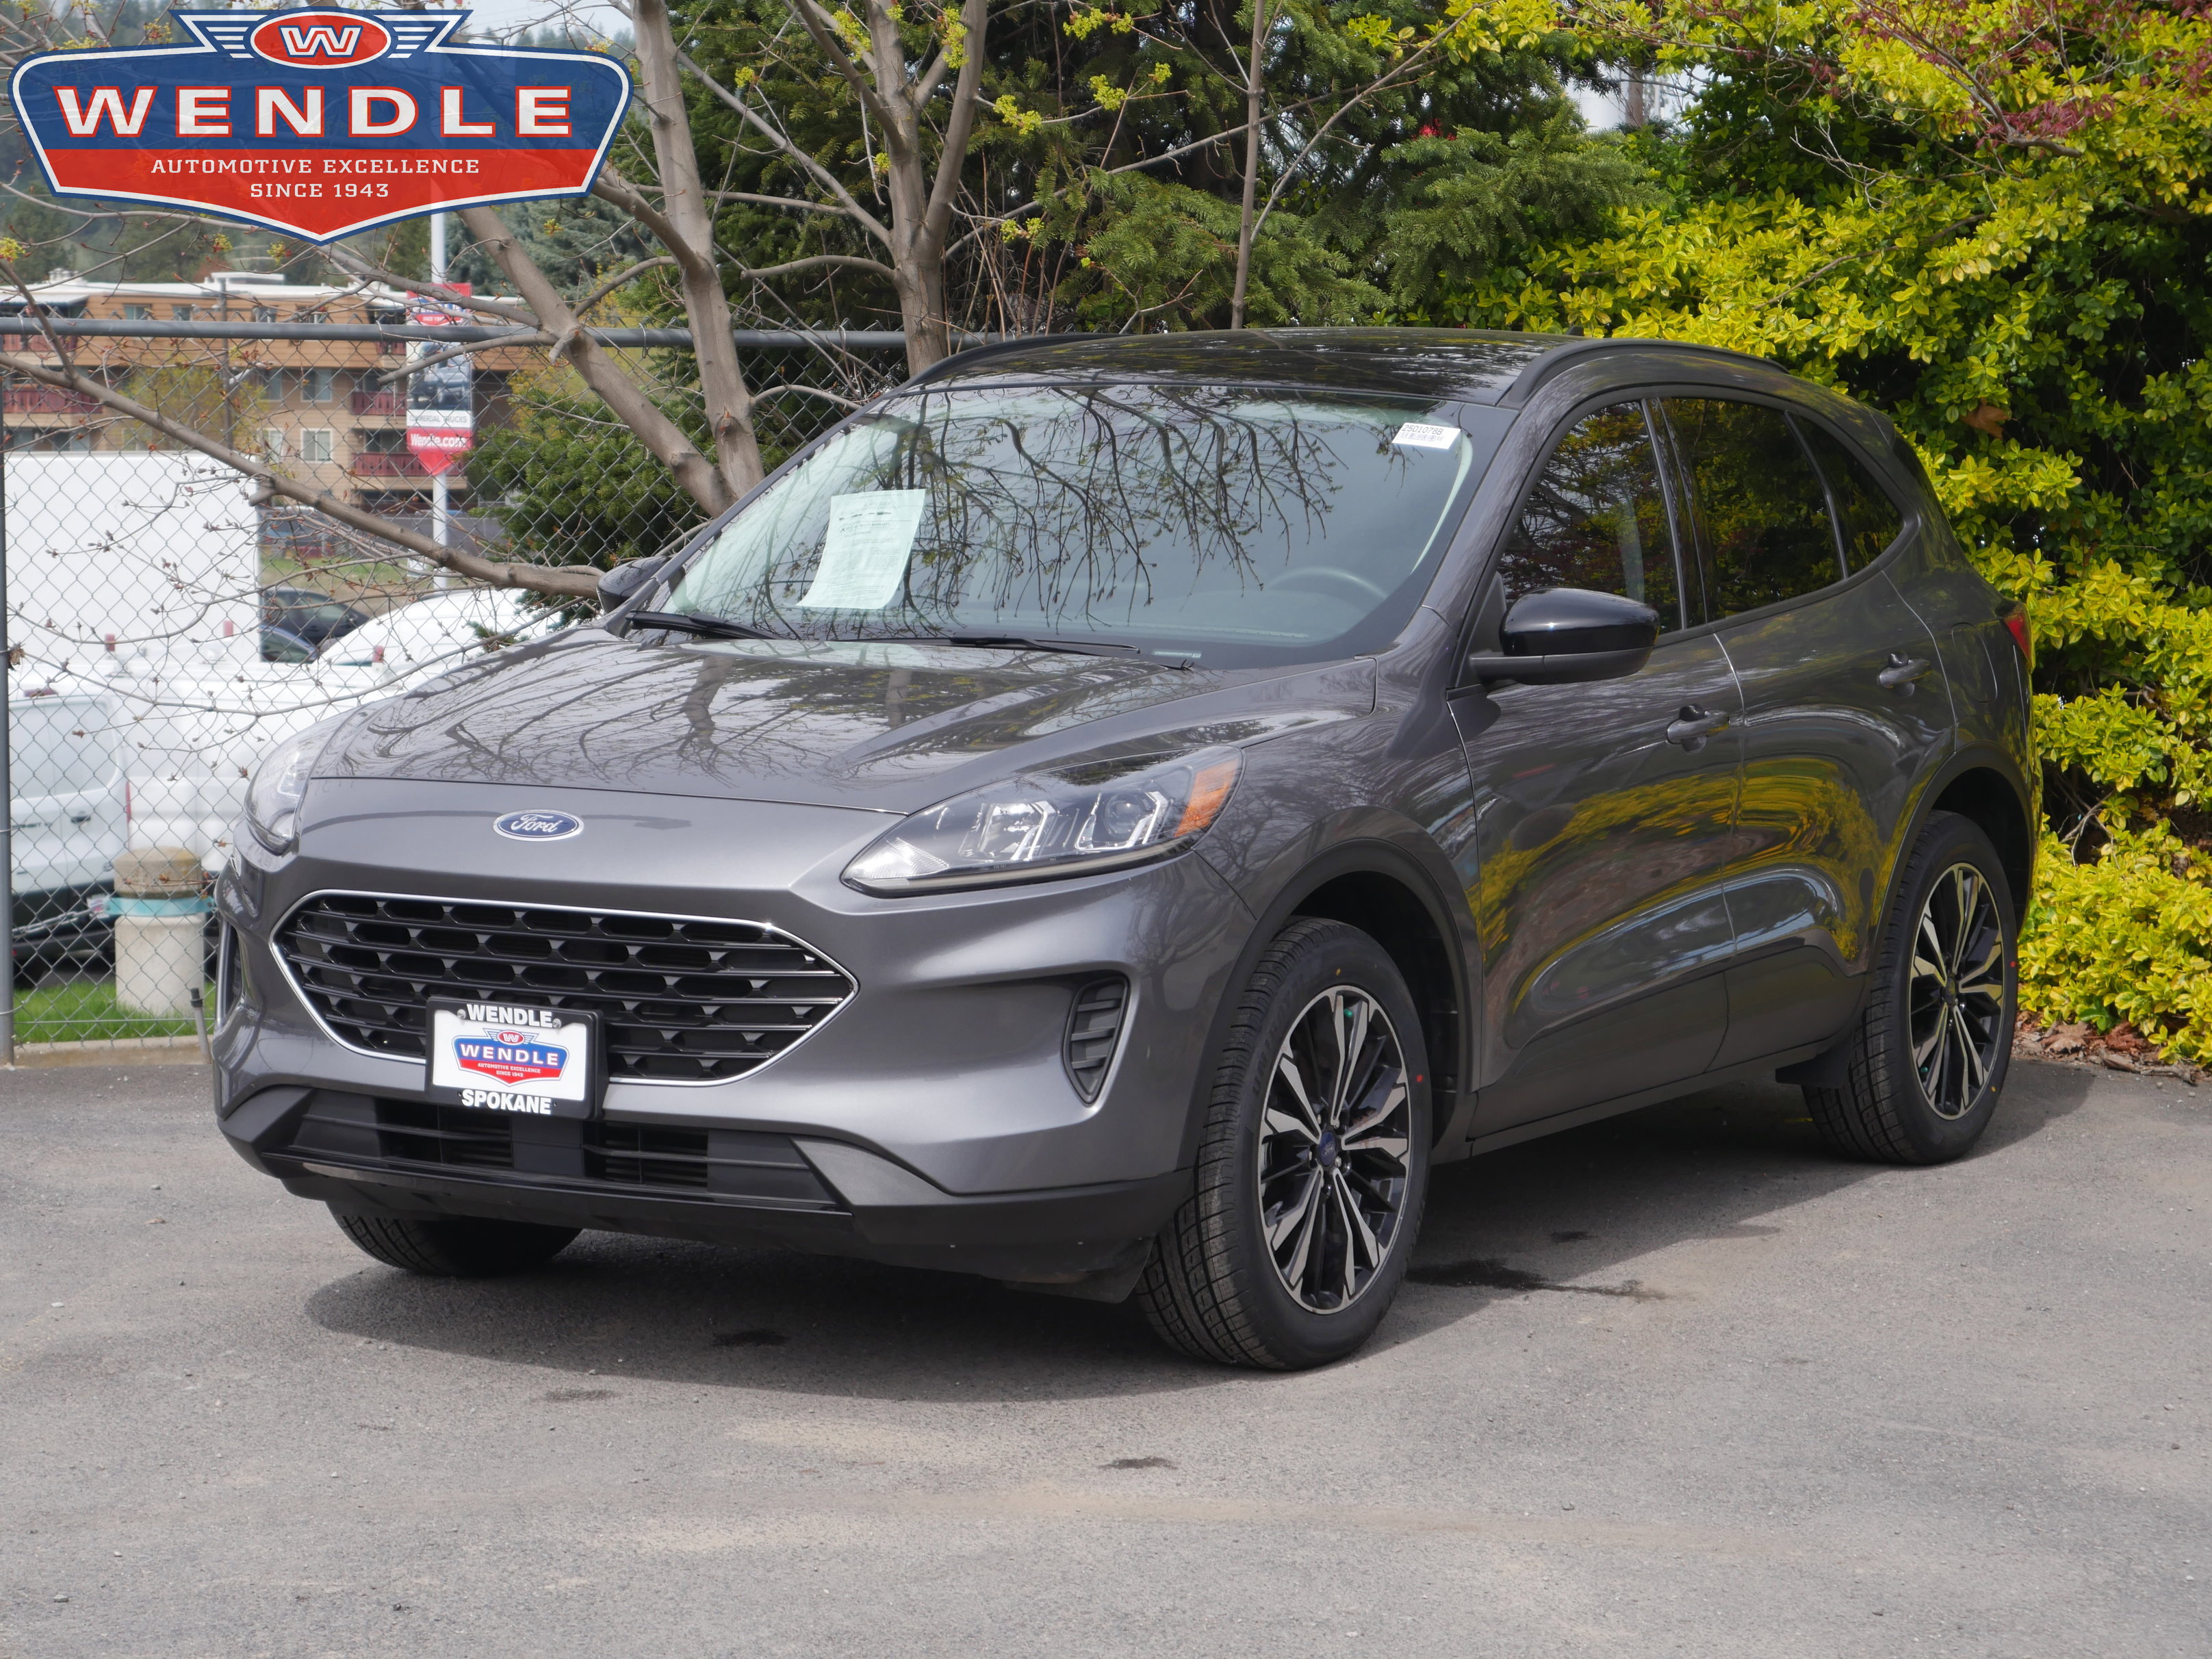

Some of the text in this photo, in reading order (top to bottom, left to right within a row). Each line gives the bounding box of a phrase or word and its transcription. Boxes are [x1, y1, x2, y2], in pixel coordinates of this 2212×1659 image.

[411, 433, 466, 447] Wendle.com
[511, 814, 563, 832] Ford
[466, 1003, 553, 1028] WENDLE
[460, 1044, 558, 1066] WENDLE
[510, 1065, 541, 1074] EXCELLENCE
[461, 1089, 552, 1116] SPOKANE
